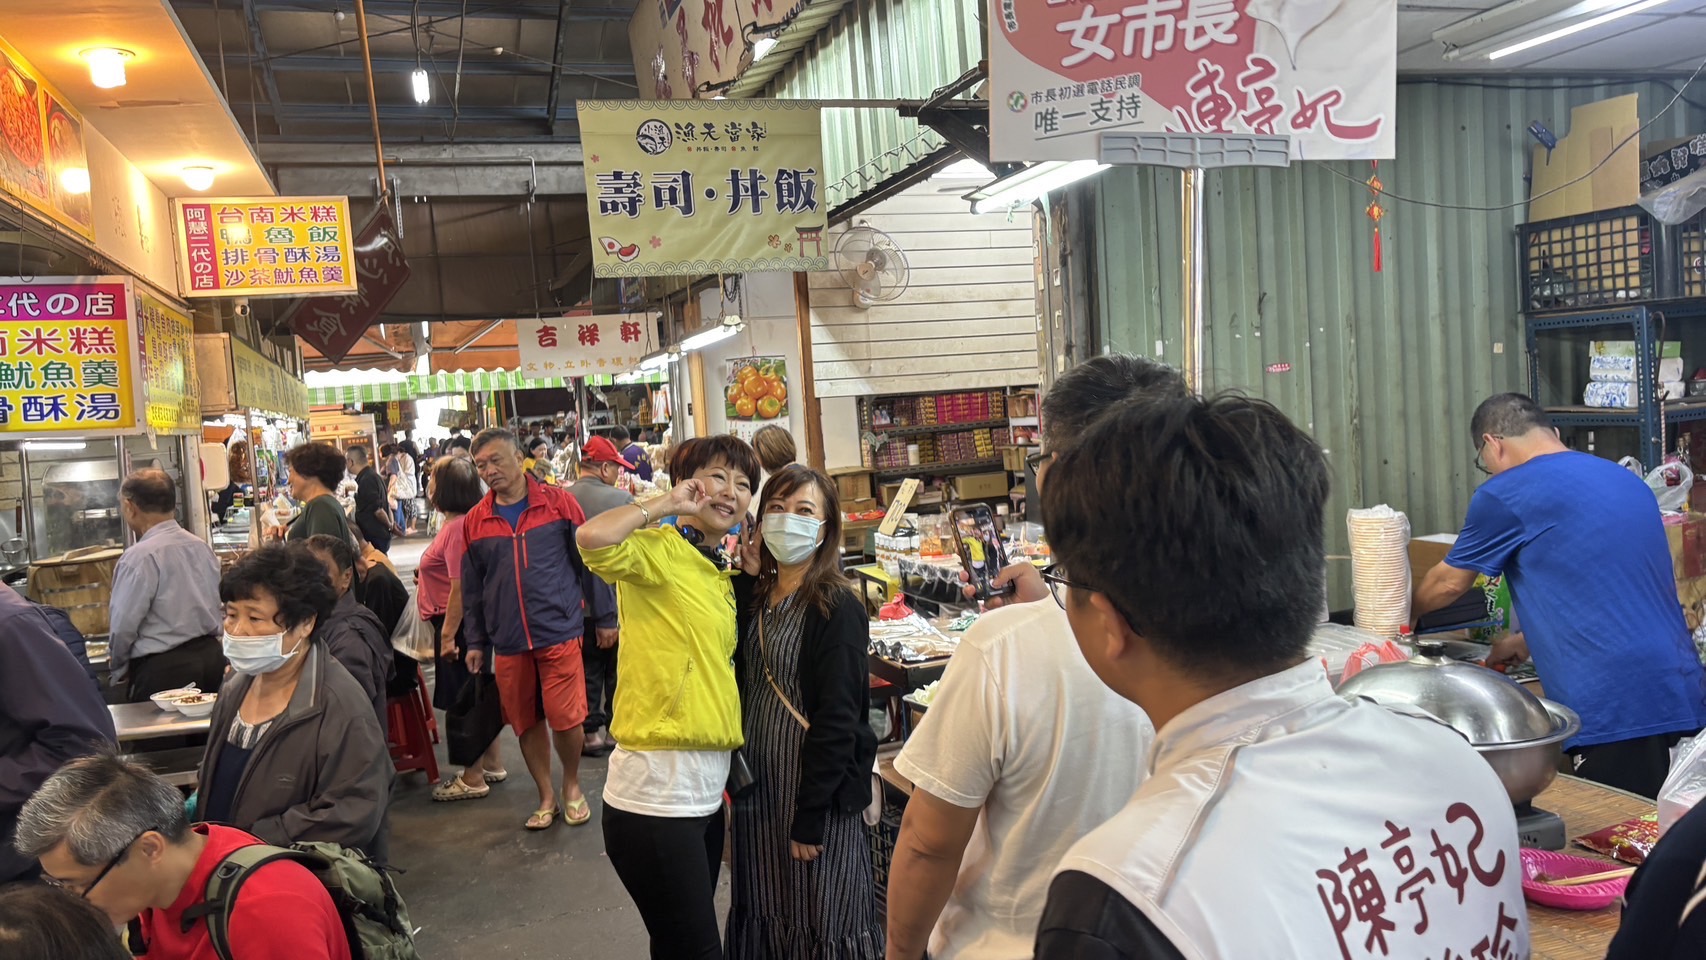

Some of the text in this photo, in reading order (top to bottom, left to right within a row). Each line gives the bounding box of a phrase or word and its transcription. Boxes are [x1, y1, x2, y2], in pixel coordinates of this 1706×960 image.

[1056, 0, 1240, 66] 女市長
[1031, 75, 1142, 105] 市長初選電話民調
[1034, 94, 1142, 134] 唯一支持
[217, 205, 338, 224] 台南米糕
[186, 208, 214, 288] 阿慧二代の店
[222, 246, 341, 266] 排骨酥湯
[224, 266, 344, 286] 沙茶魷魚羹
[0, 292, 115, 317] 代の店
[0, 327, 117, 356] 米糕
[536, 321, 642, 347] 吉祥軒
[0, 360, 119, 388] 魷魚羹
[1316, 802, 1506, 960] 陳亭妃
